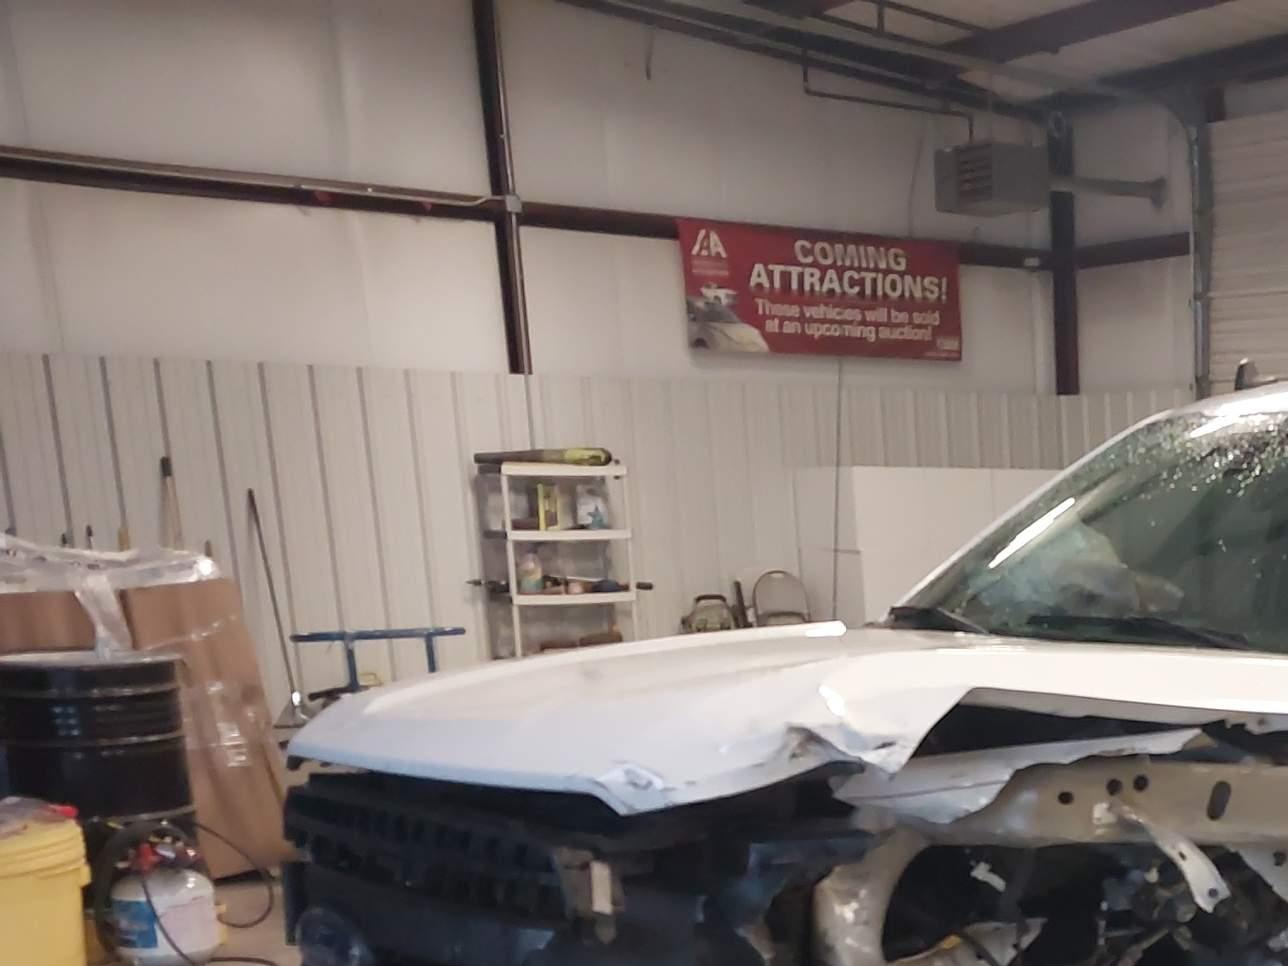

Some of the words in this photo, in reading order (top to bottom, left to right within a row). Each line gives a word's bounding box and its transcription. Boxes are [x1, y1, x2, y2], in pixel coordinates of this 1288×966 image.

[794, 239, 907, 271] COMING
[749, 262, 947, 301] ATTRACTIONS!
[754, 297, 800, 318] These
[865, 307, 889, 323] will
[912, 311, 940, 326] sold
[765, 317, 779, 333] at
[782, 320, 803, 335] an
[804, 321, 876, 342] upcoming
[878, 324, 932, 341] auction!
